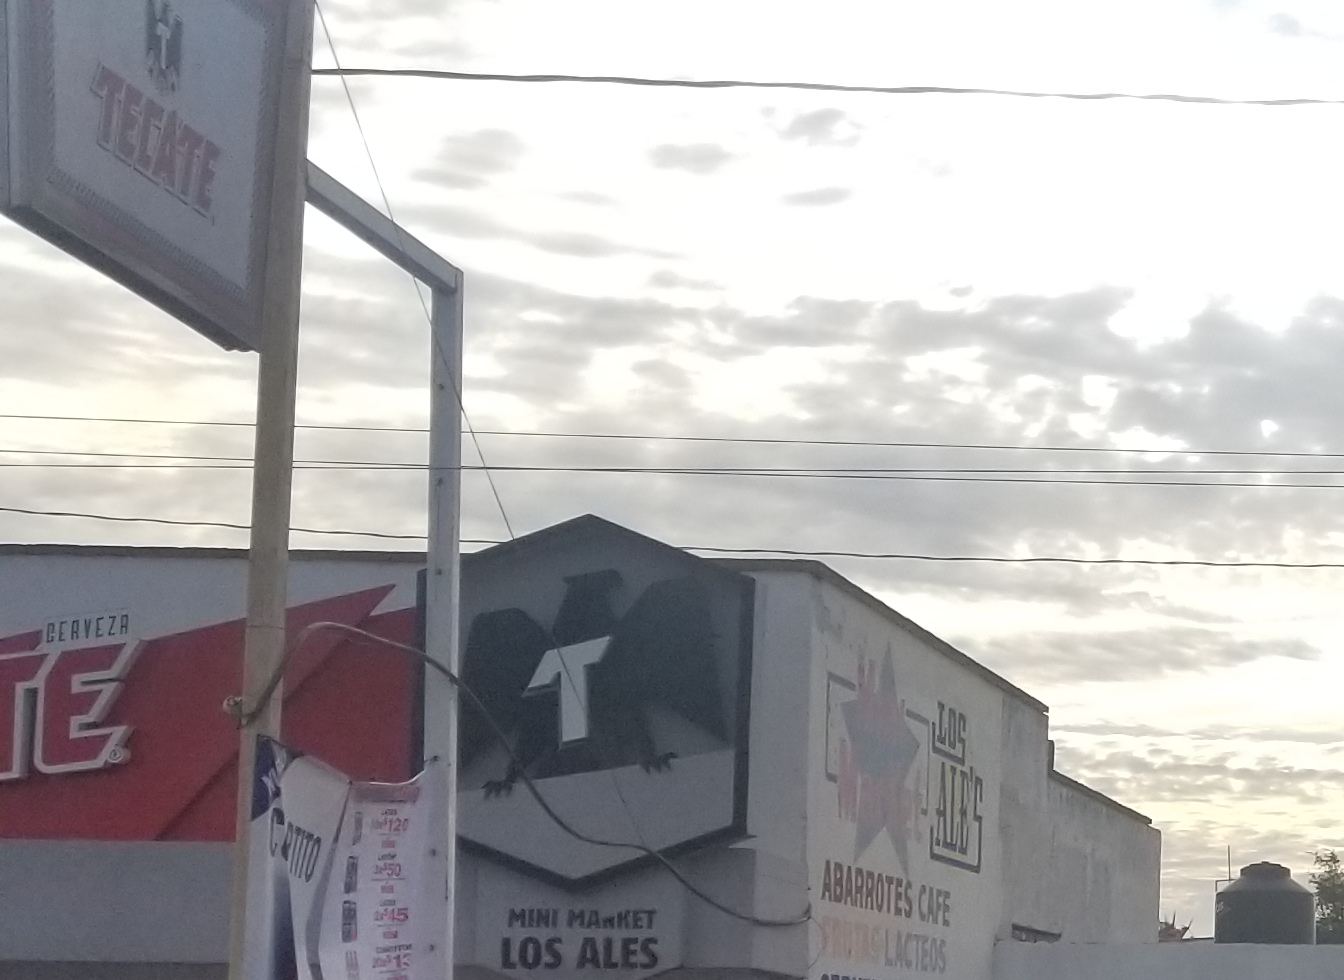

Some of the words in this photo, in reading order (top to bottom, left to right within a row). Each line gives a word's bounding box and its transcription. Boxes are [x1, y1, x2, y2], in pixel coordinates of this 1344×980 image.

[90, 62, 222, 219] TECATE
[46, 612, 130, 644] CERVEZA
[936, 699, 967, 753] LOS
[820, 859, 913, 919] ABARROTES
[918, 884, 952, 927] CAFE
[507, 906, 558, 930] MINI
[566, 906, 657, 930] MARKET
[502, 936, 562, 971] LOS
[576, 936, 659, 971] ALES
[884, 928, 947, 975] LACTEOS
